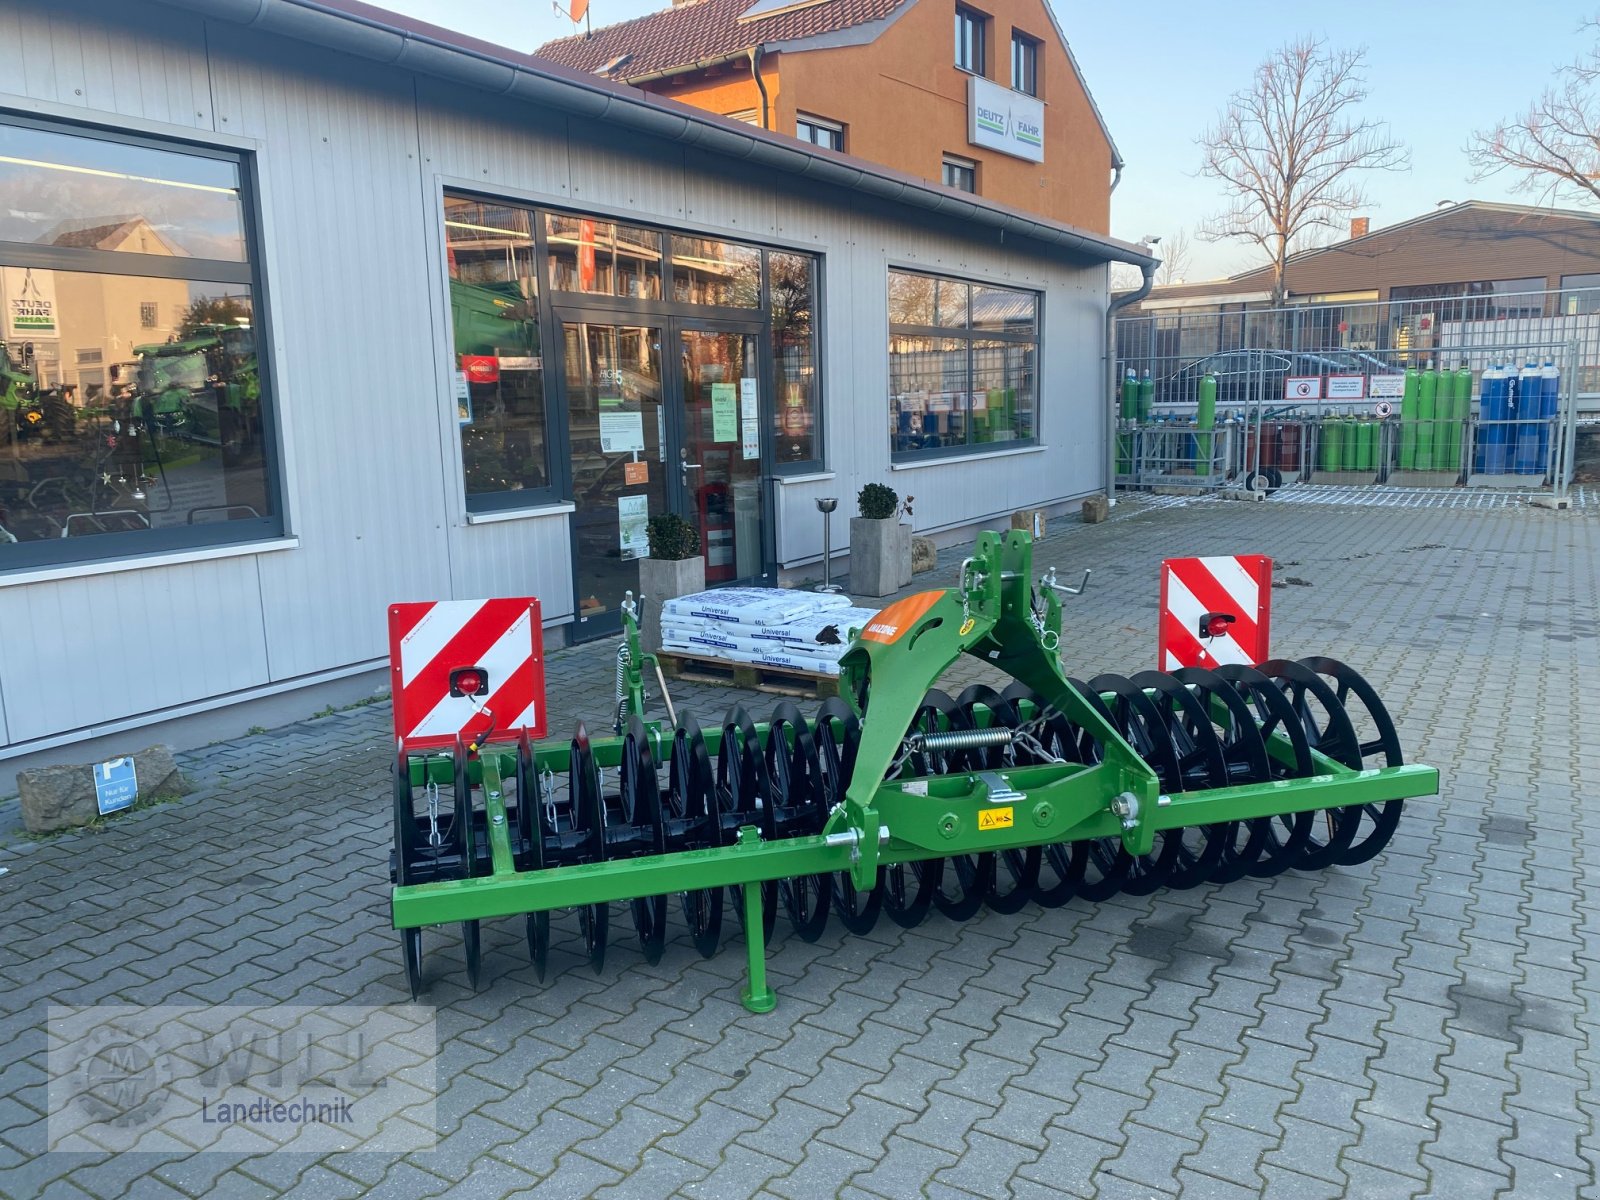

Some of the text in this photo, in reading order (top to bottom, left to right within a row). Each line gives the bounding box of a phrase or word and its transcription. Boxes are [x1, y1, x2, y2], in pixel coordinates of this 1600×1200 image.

[977, 107, 1040, 136] DEUTZ FAHR
[701, 605, 730, 615] Universal
[700, 631, 728, 641] Universal
[761, 627, 791, 636] Universal
[762, 653, 791, 663] Universal
[104, 794, 132, 806] Kunden
